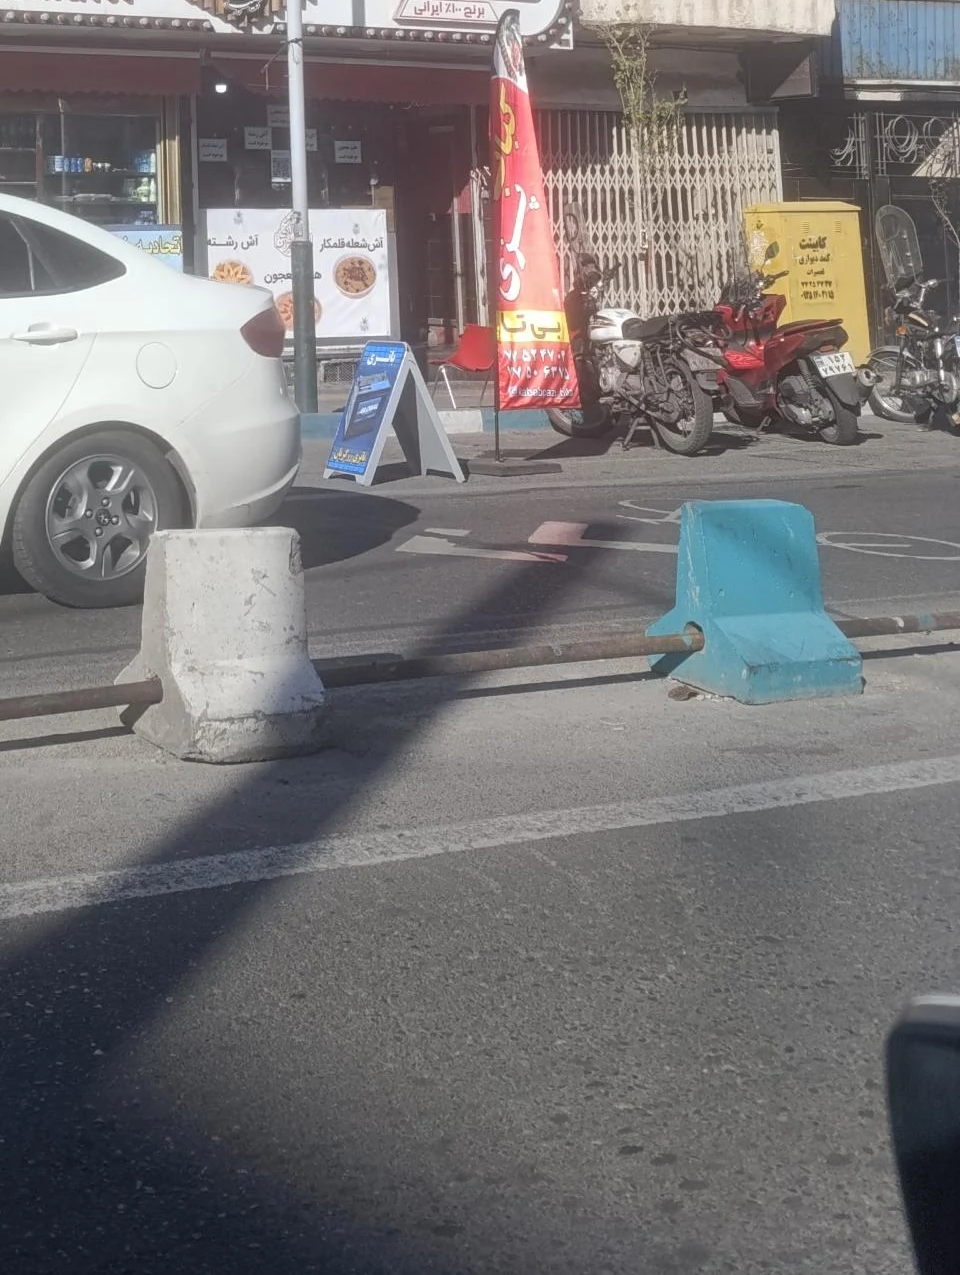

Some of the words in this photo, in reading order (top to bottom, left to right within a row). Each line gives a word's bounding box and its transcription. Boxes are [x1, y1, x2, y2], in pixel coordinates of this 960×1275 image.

[413, 0, 442, 16] ایرانی
[463, 4, 486, 18] برنج
[207, 237, 239, 250] رشته
[241, 234, 259, 250] آش
[320, 238, 345, 252] قلمکار
[368, 237, 383, 252] آش
[799, 236, 827, 252] کابینت
[264, 272, 293, 284] عجون
